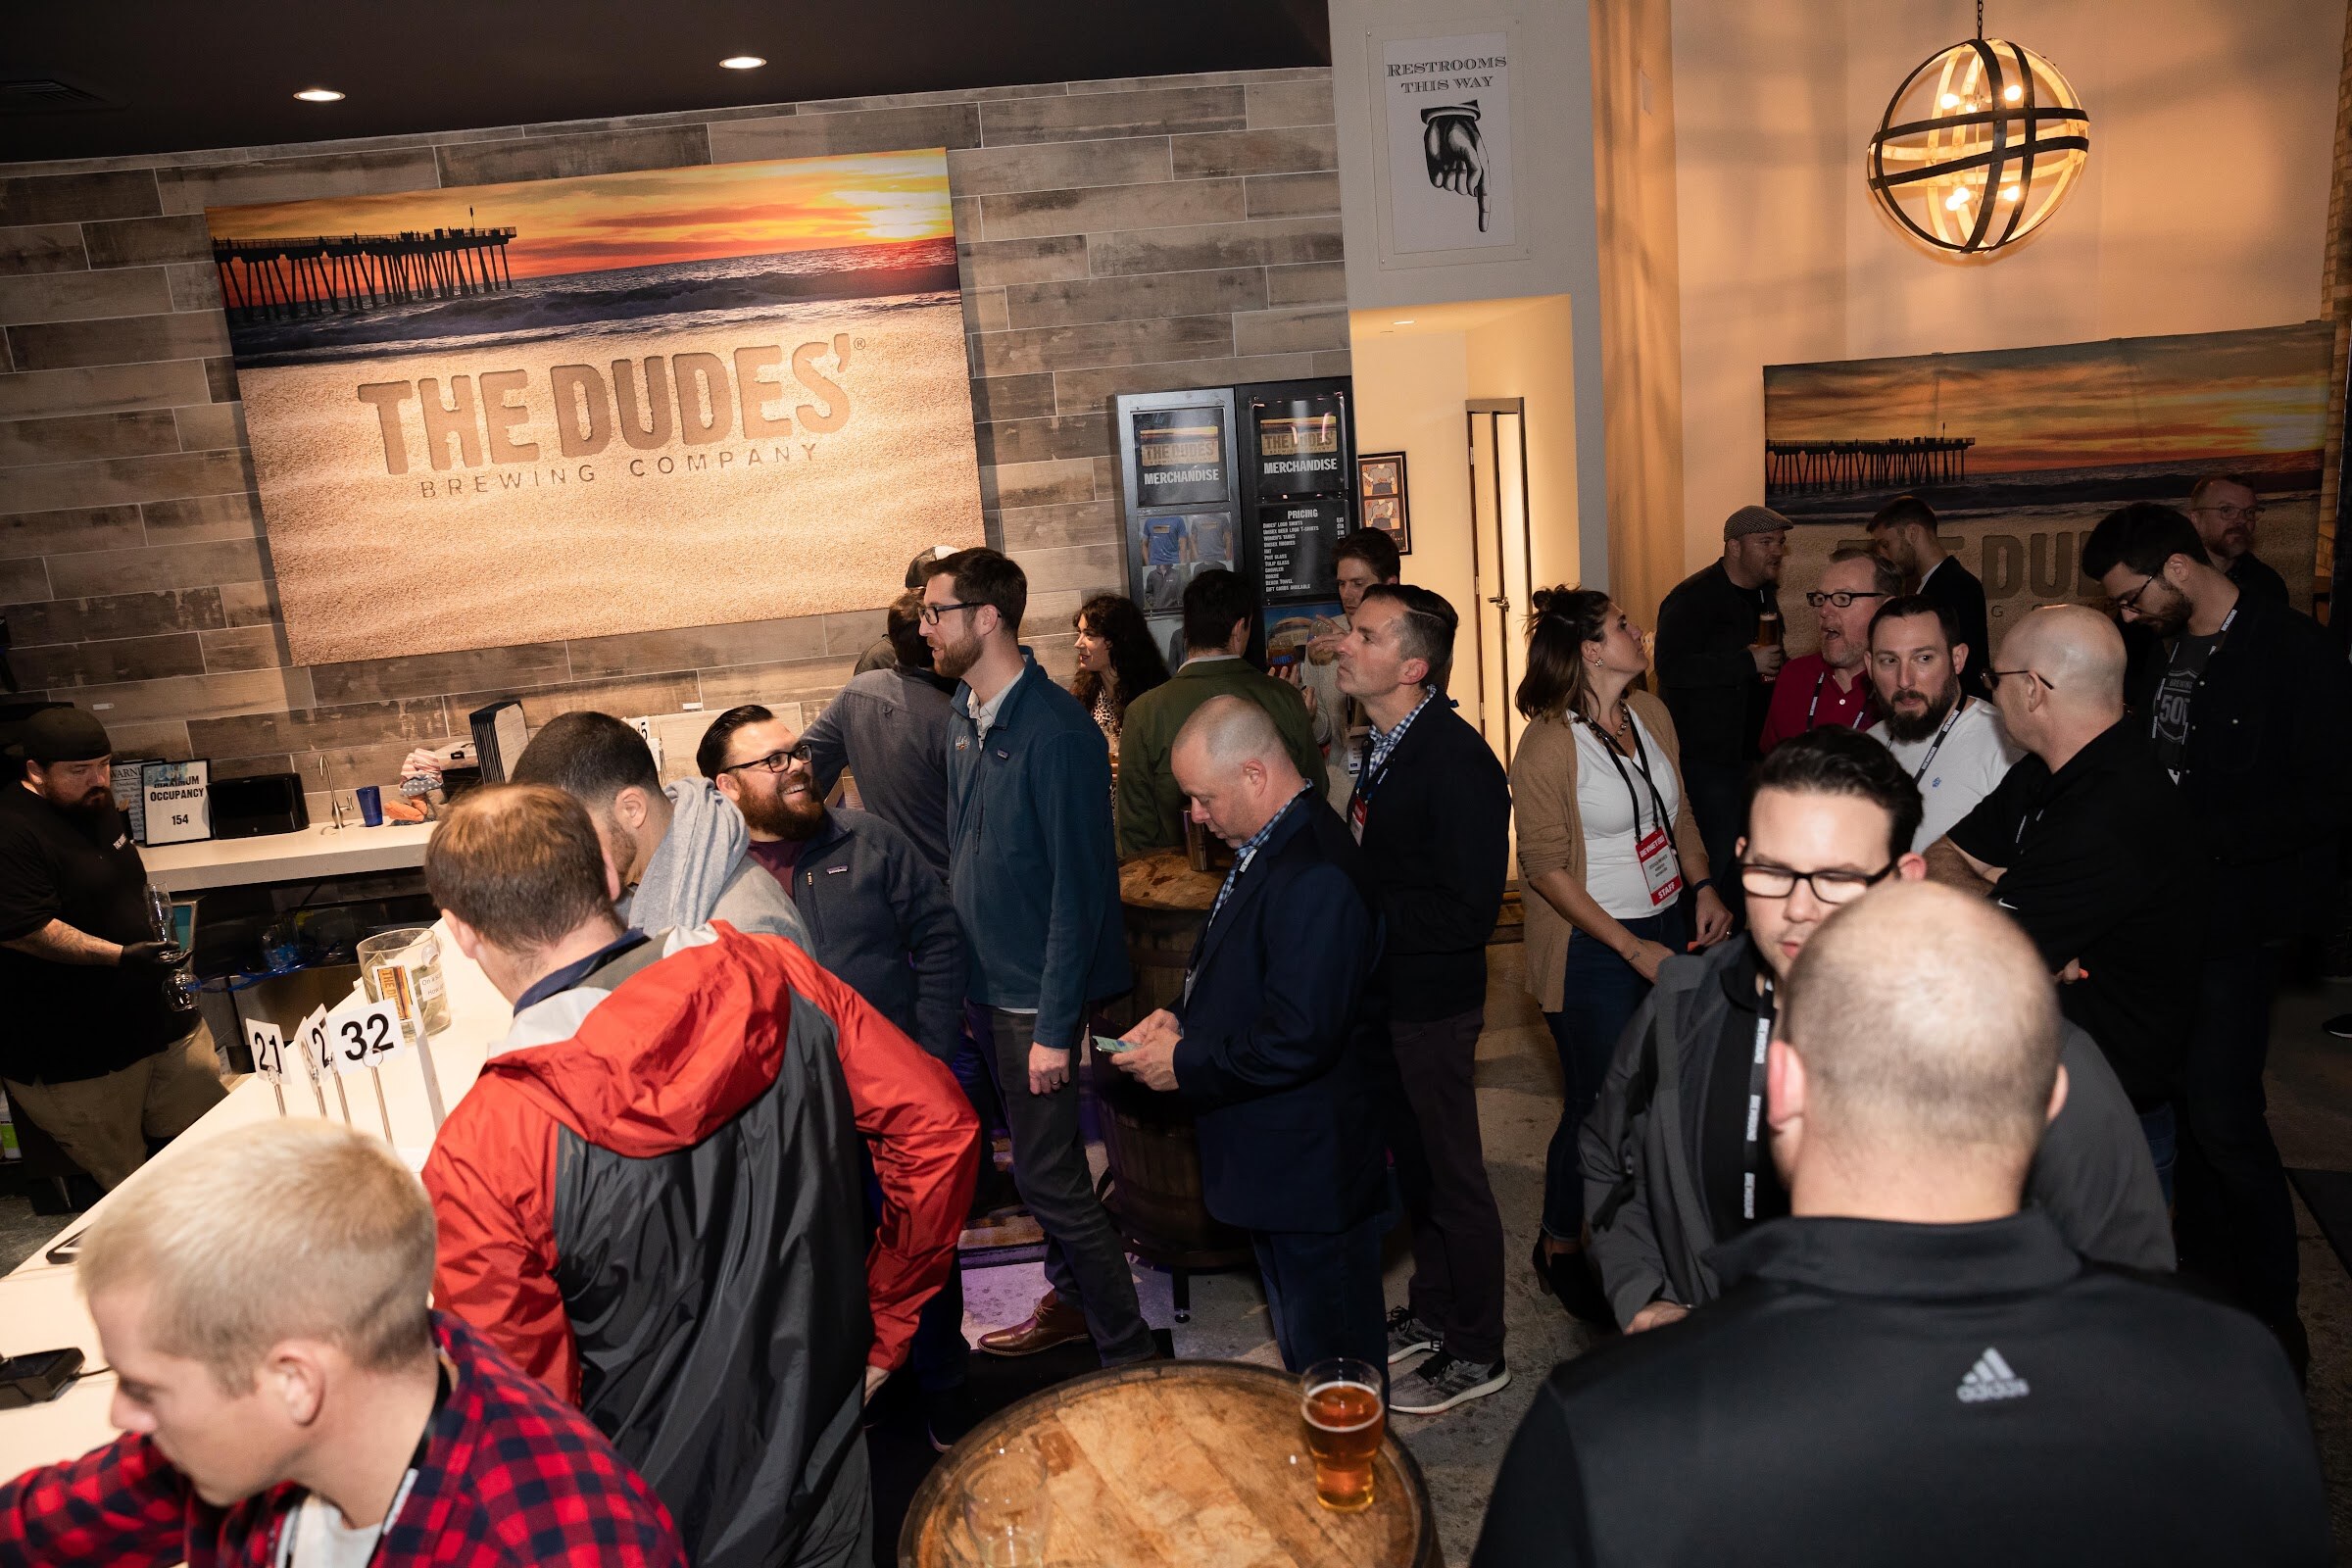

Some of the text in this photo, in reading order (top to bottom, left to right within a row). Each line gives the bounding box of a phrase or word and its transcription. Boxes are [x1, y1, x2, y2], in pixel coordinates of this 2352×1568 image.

[1387, 56, 1507, 77] RESTROOMS
[1401, 75, 1494, 94] THIS WAY
[358, 369, 541, 475] THE
[1264, 434, 1290, 450] THE
[1145, 444, 1169, 461] THE
[421, 442, 819, 499] BREWING COMPANY
[1263, 458, 1338, 475] MERCHANDISE
[1144, 468, 1220, 485] MERCHANDISE
[1287, 509, 1319, 519] PRICING
[150, 787, 205, 802] OCCUPANCY
[172, 813, 189, 825] 154
[1657, 881, 1676, 900] STAFF
[382, 969, 396, 989] THE
[341, 1012, 395, 1061] 32
[254, 1032, 283, 1075] 21
